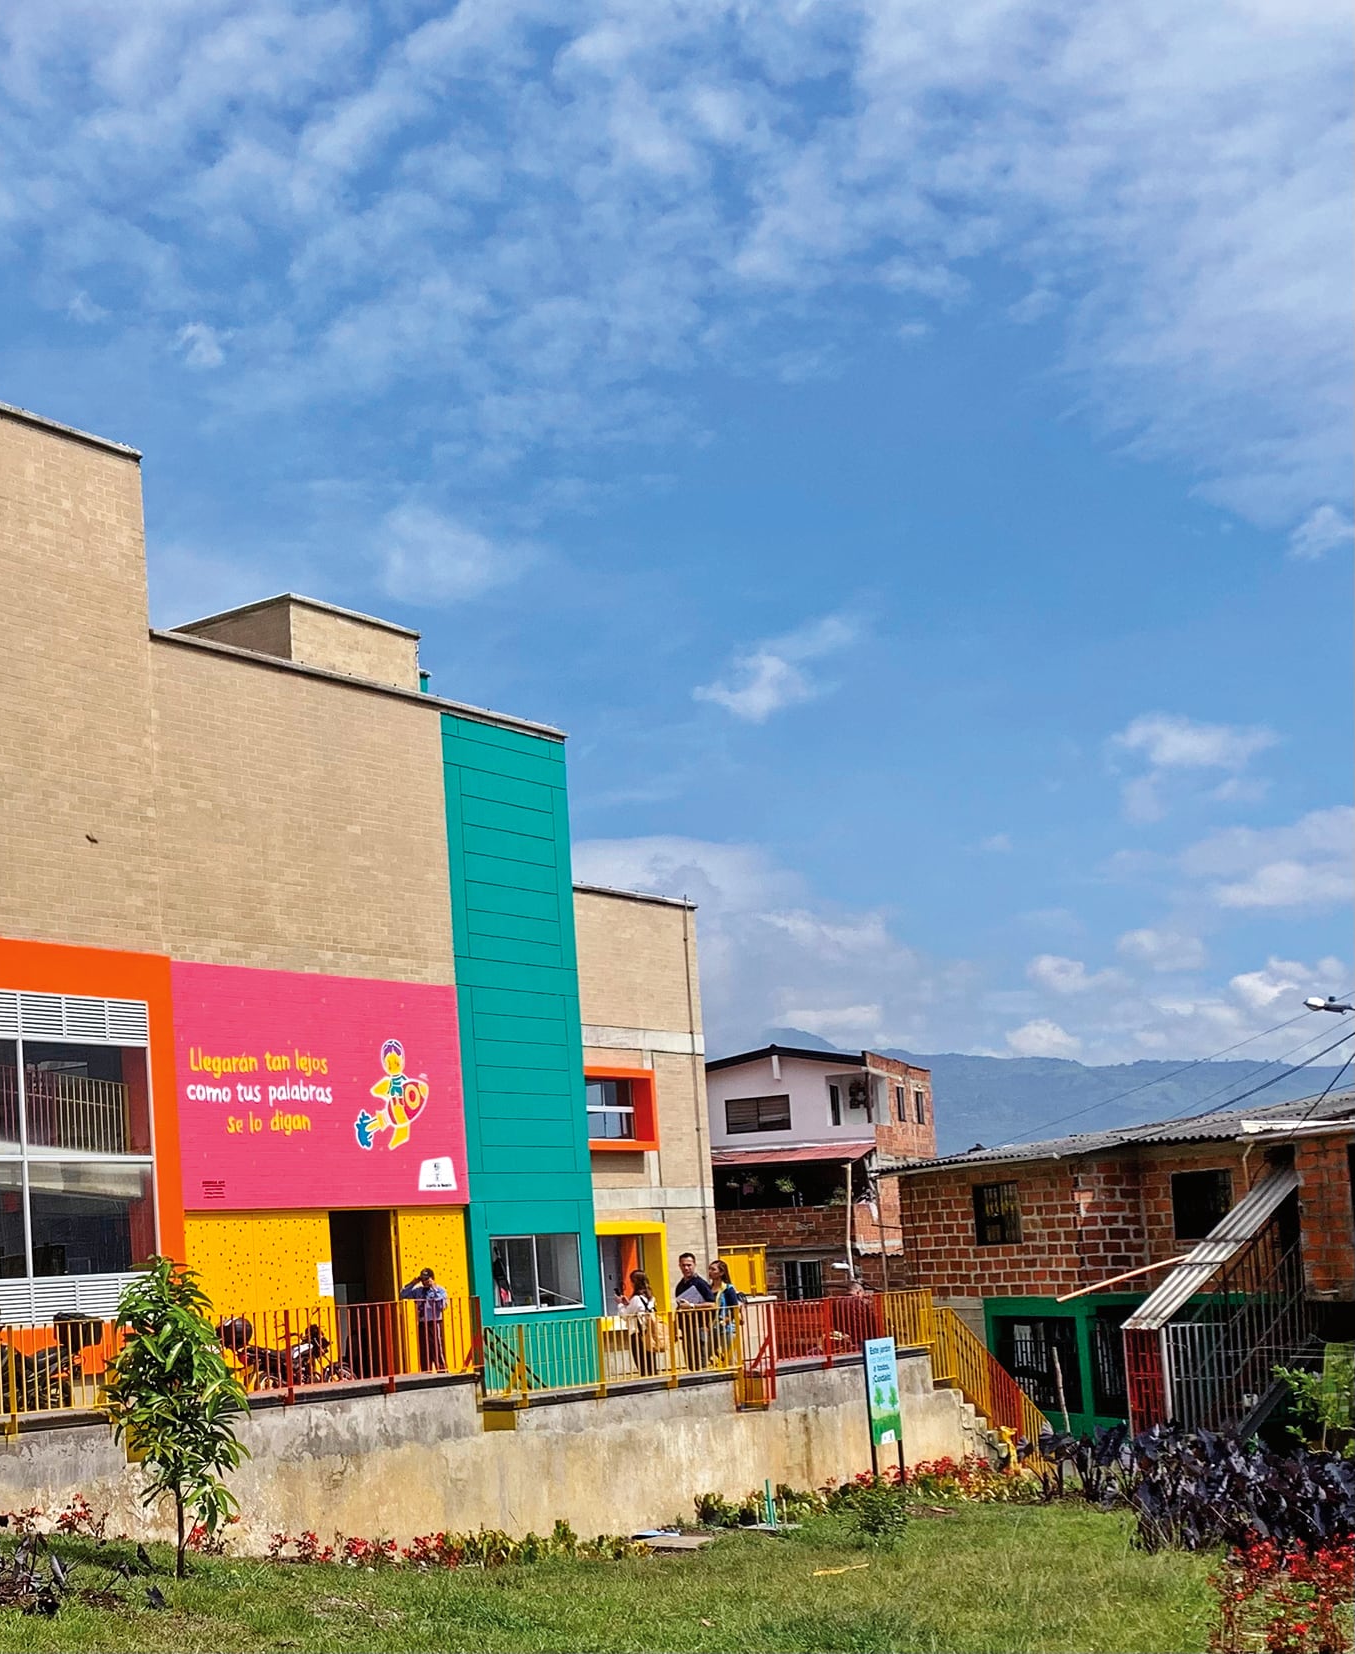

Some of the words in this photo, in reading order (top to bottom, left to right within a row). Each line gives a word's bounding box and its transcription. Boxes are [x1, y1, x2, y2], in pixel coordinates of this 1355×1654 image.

[189, 1046, 259, 1080] Llegarán
[263, 1051, 292, 1072] tan
[294, 1047, 329, 1077] lejos
[186, 1083, 232, 1104] como
[236, 1082, 262, 1103] tus
[268, 1077, 334, 1108] palabras
[226, 1115, 244, 1134] se
[248, 1111, 263, 1134] lo
[269, 1109, 312, 1136] digan
